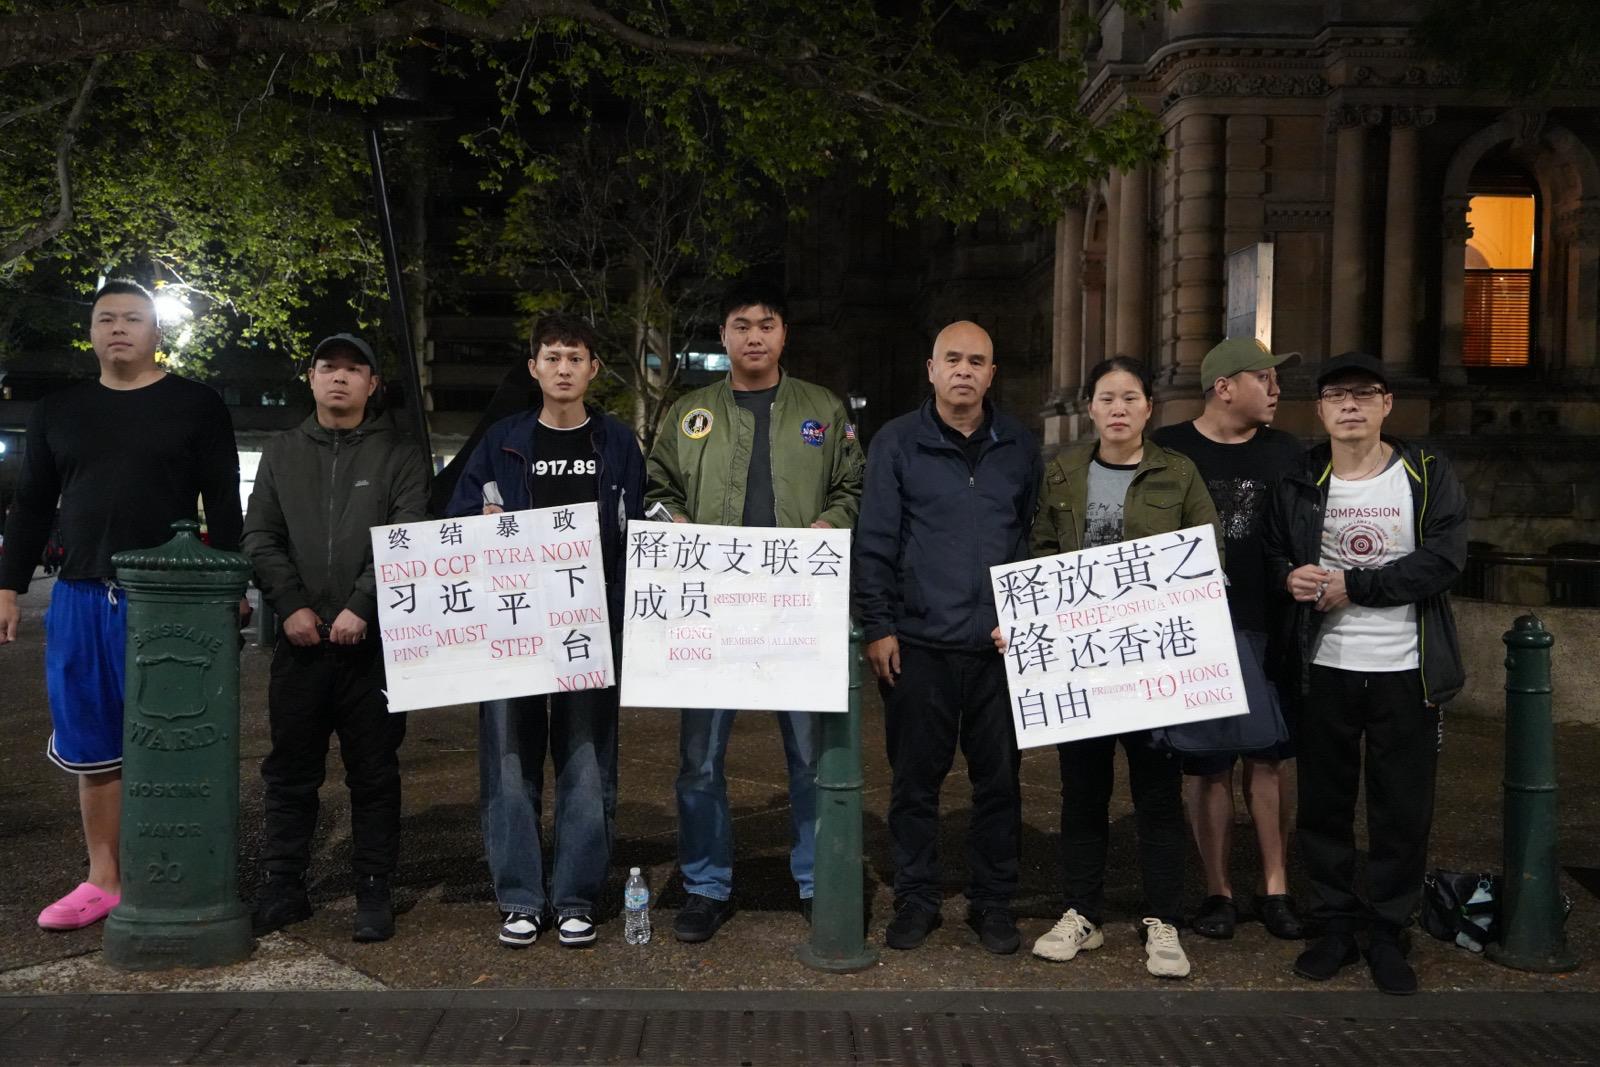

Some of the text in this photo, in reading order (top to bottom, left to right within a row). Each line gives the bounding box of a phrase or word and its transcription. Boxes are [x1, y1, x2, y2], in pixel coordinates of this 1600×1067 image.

[532, 460, 596, 476] 917.89
[1324, 507, 1400, 518] COMPASSION
[380, 540, 592, 583] END CCP TYRA NOW
[629, 530, 844, 577] 释放支联会
[491, 573, 530, 591] NNY
[996, 533, 1217, 620] 释放黄之
[630, 581, 711, 620] 成员
[714, 592, 767, 605] RESTORE
[1056, 581, 1222, 631] FREE JOSHUA WONG
[435, 624, 488, 647] MUST
[490, 636, 544, 659] STEP
[548, 607, 602, 627] DOWN
[670, 627, 817, 646] HONG MEMBERS ALLIANCE
[1007, 615, 1197, 675] 锋还香港
[394, 645, 430, 662] PING
[669, 647, 712, 660] KONG
[556, 670, 608, 691] NOW
[1092, 663, 1229, 701] FREEDOM TO HONG
[1017, 683, 1091, 730] 自由
[1184, 687, 1233, 708] KONG
